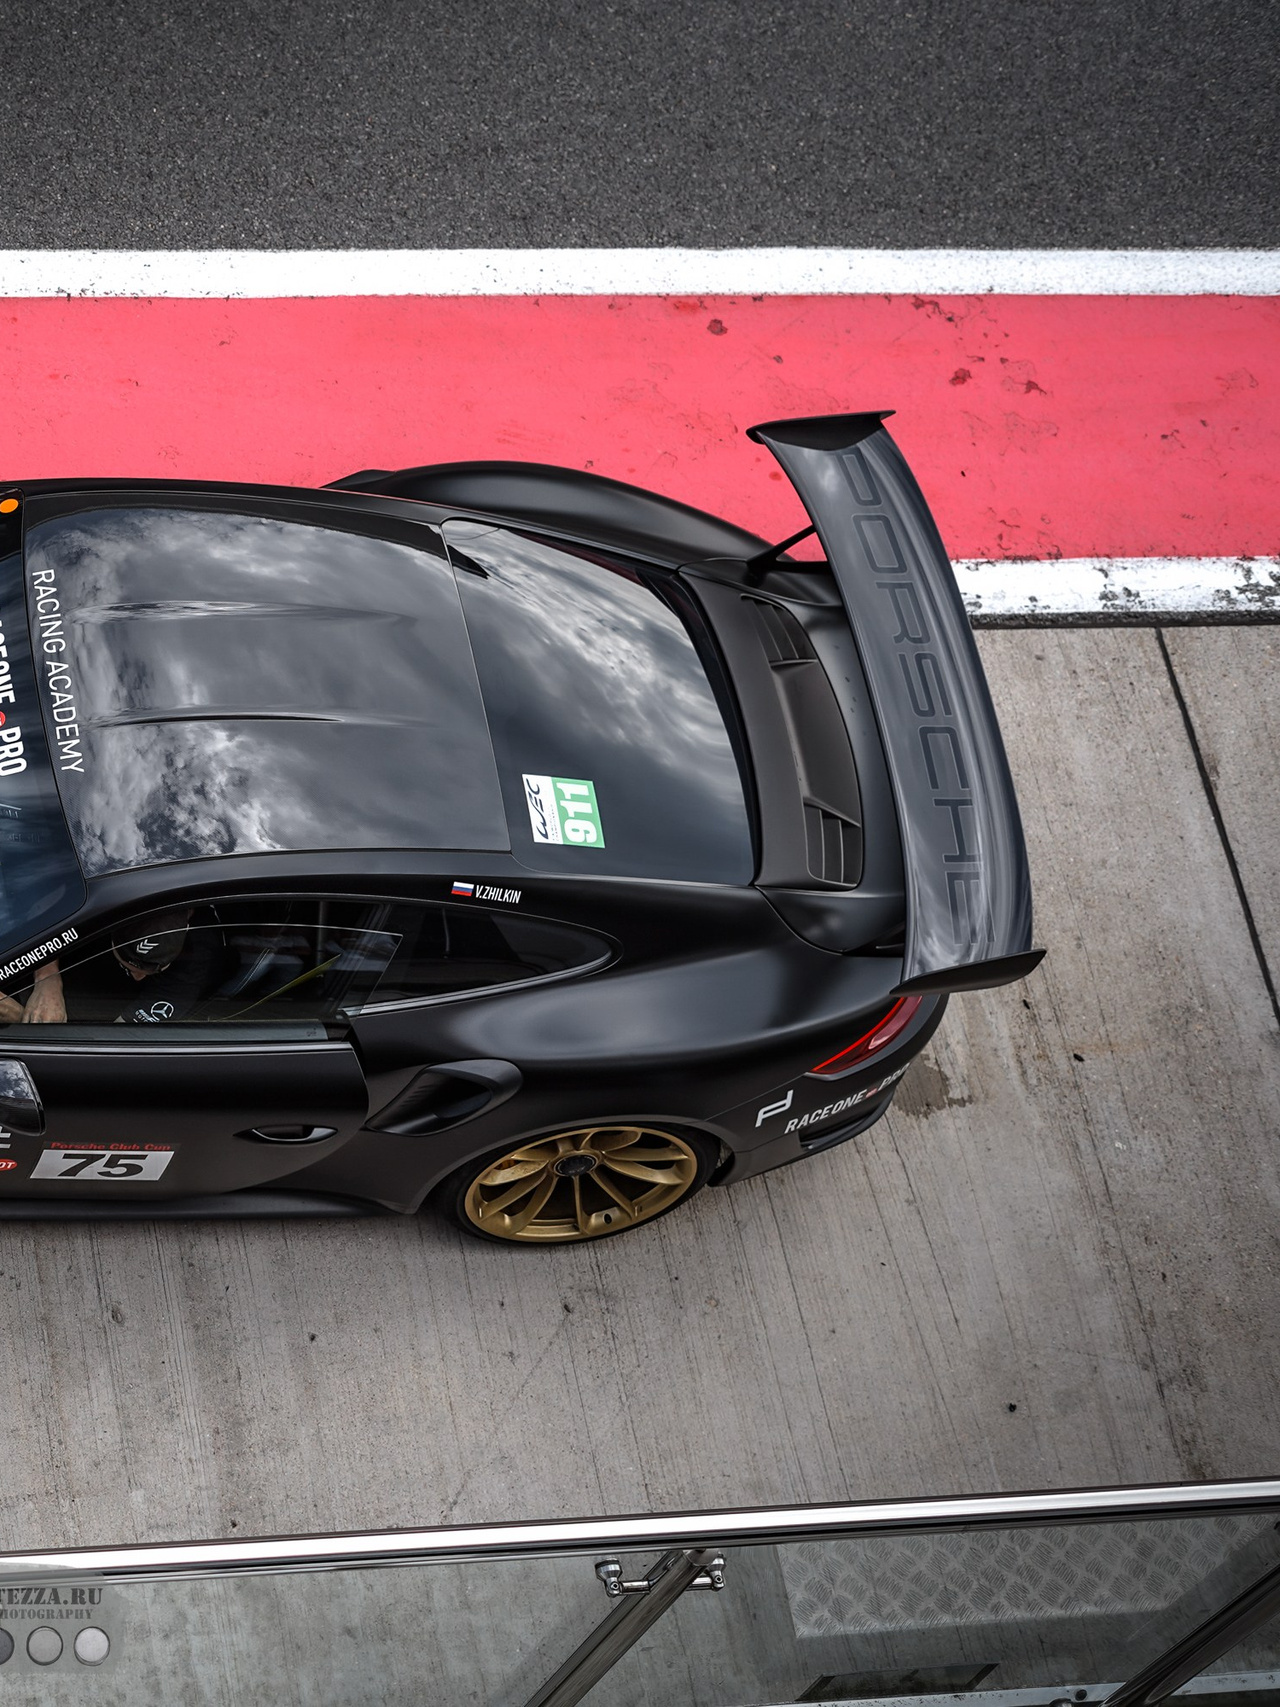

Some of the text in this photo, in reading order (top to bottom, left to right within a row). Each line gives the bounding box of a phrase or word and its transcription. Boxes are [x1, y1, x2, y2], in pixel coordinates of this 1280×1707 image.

[31, 568, 84, 772] RACING ACADEMY
[835, 446, 996, 945] PORSCHE
[525, 777, 548, 839] WEC
[556, 781, 597, 843] 911
[475, 884, 521, 904] V.ZHILKIN
[783, 1088, 867, 1133] RACEONE
[50, 1141, 171, 1151] Porsche Club Cup
[57, 1153, 148, 1177] 75
